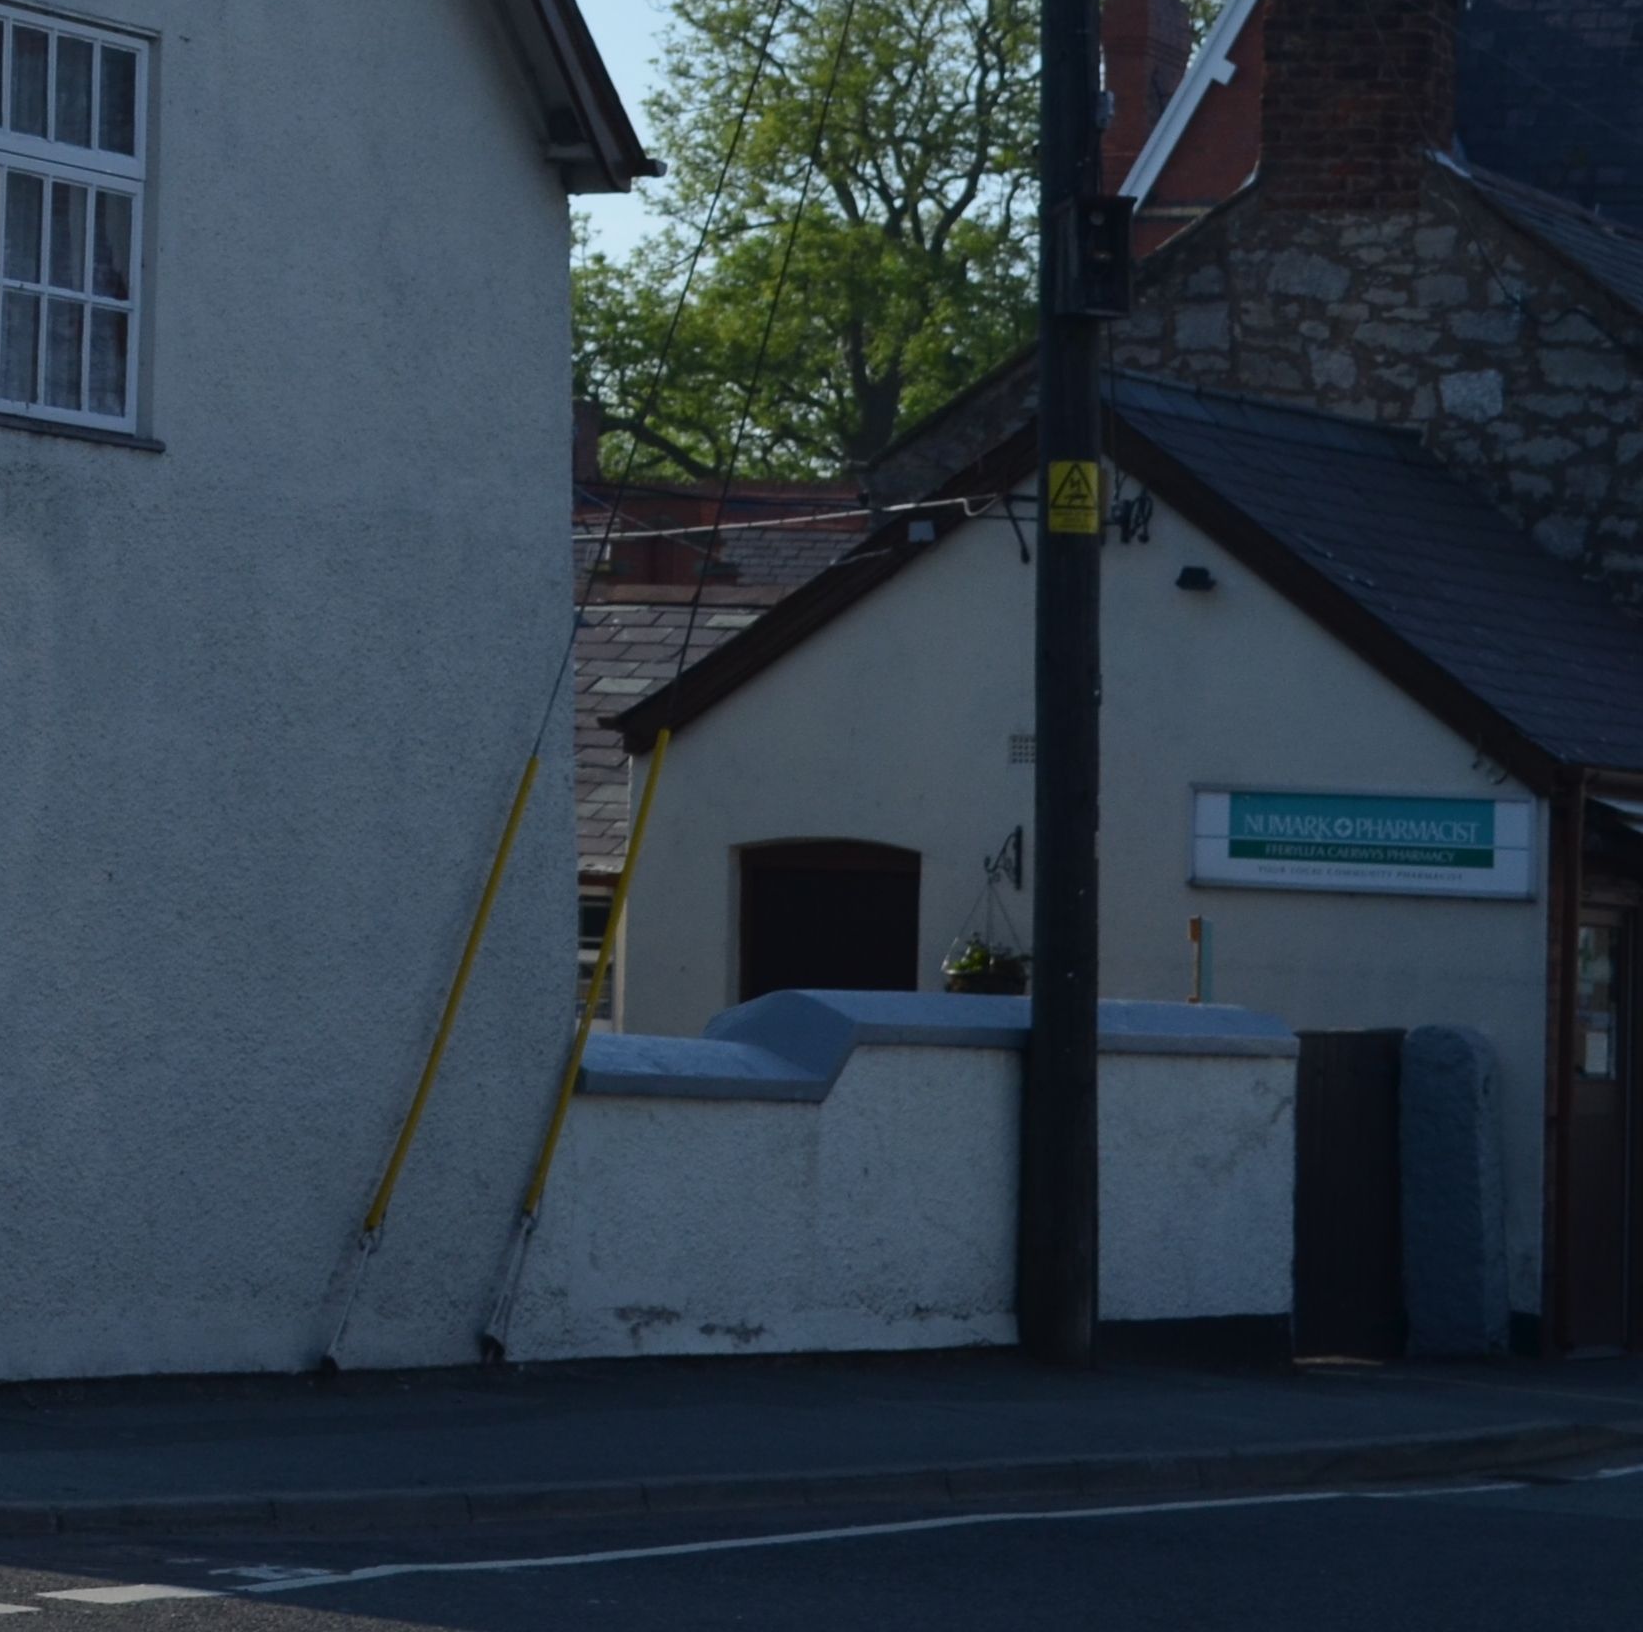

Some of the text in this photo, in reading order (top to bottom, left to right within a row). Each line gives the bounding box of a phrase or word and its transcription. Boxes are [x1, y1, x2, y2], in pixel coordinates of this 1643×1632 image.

[1244, 813, 1481, 844] NUMARK PHARMACIST
[1326, 845, 1385, 862] CAERWYS
[1386, 848, 1456, 864] PHARMACY
